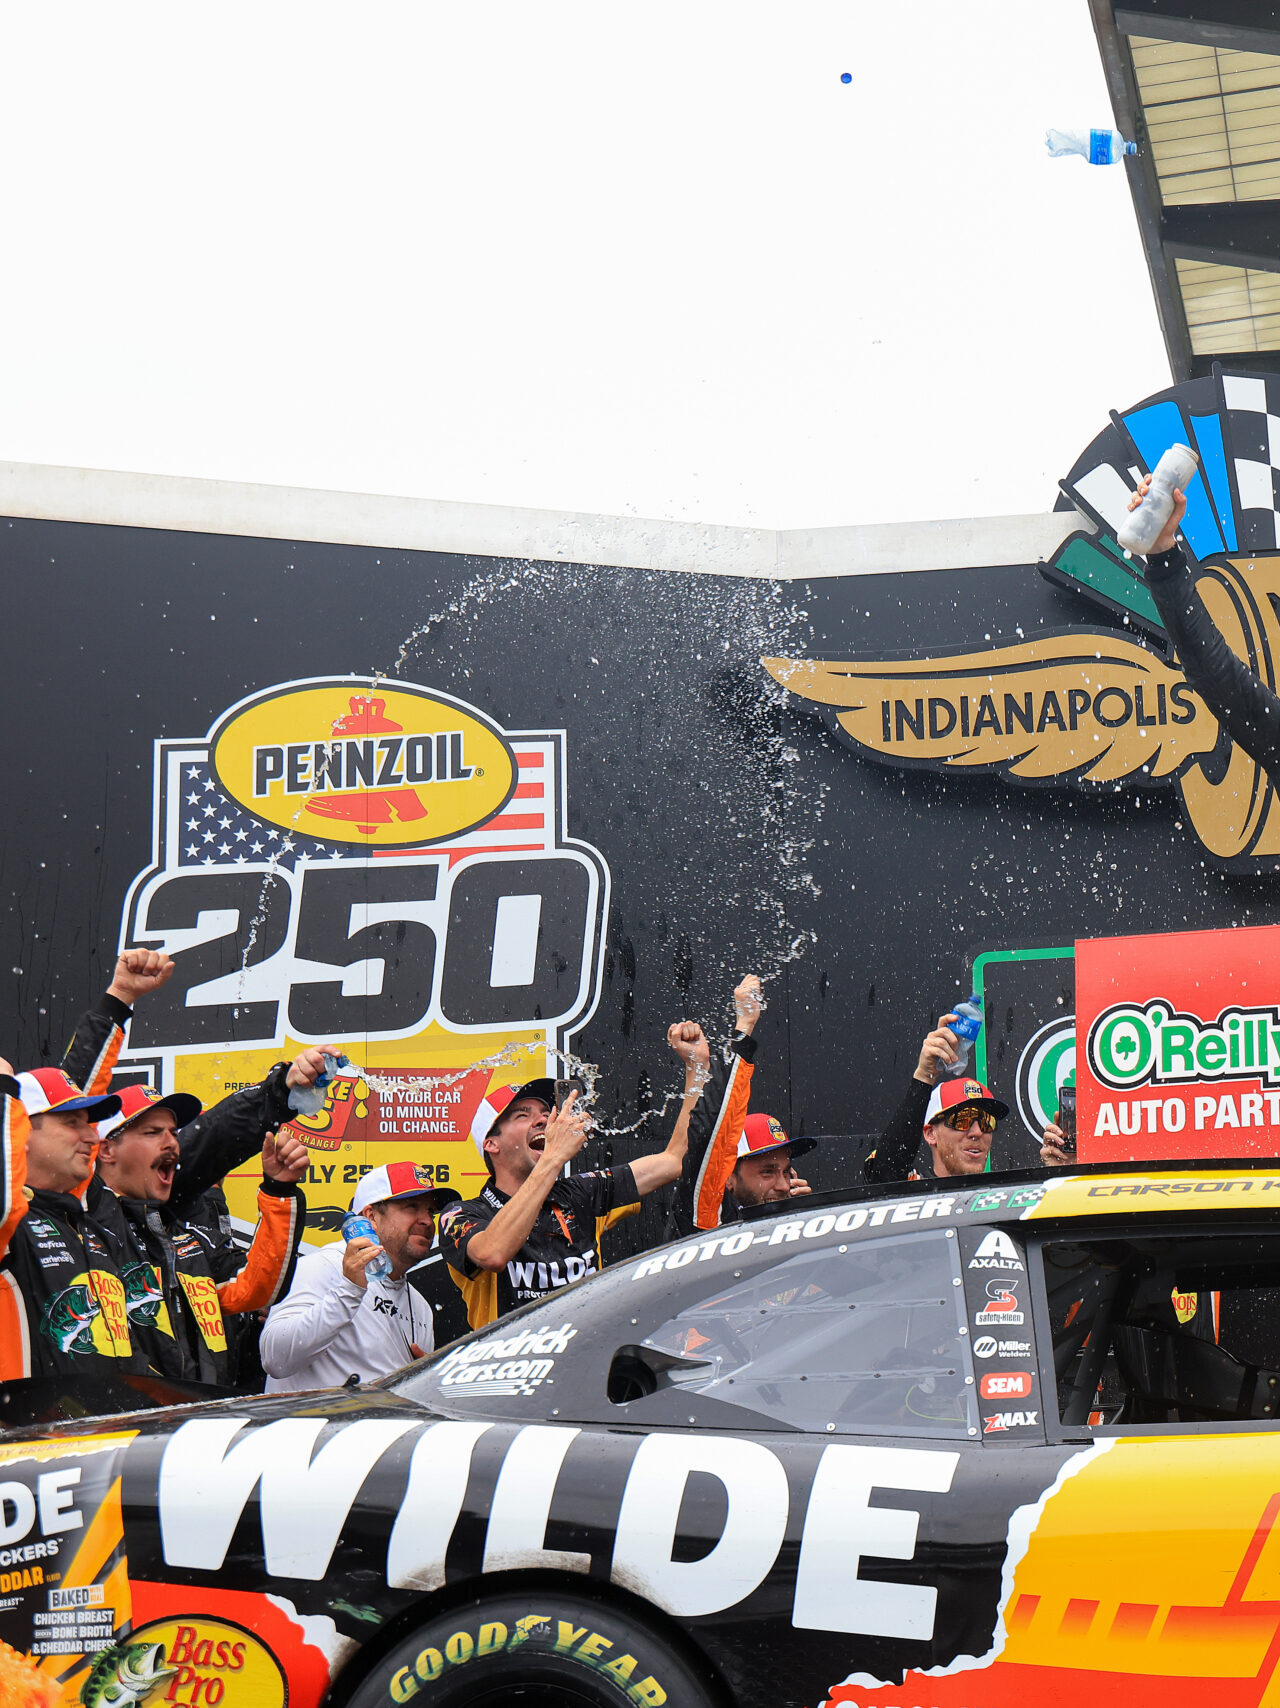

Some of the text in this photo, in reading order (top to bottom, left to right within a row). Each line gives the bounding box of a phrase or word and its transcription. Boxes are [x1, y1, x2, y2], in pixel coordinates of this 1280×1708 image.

[881, 681, 1197, 744] INDIANAPOLIS
[255, 733, 472, 796] PENNZOIL
[128, 857, 591, 1050] 250
[325, 1079, 352, 1101] KE
[379, 1090, 461, 1104] IN YOUR CAR
[380, 1106, 449, 1119] 10 MINUTE
[1093, 1094, 1186, 1138] AUTO
[379, 1120, 460, 1134] OIL CHANGE.
[298, 1133, 336, 1150] CHANGE
[300, 1164, 337, 1184] ULY
[427, 1163, 450, 1183] 26
[1087, 1180, 1265, 1199] CARSON
[631, 1197, 955, 1281] ROTO-ROOTER
[507, 1249, 597, 1289] WILDE
[968, 1258, 1025, 1272] AXALTA
[88, 1271, 123, 1297] Bass
[99, 1296, 123, 1318] Pro
[978, 1311, 1022, 1324] safety-kleen
[105, 1317, 131, 1343] Sho
[437, 1322, 579, 1376] Hendrick
[998, 1340, 1031, 1351] Miller
[998, 1350, 1031, 1358] Welders
[440, 1358, 555, 1386] Cars.com
[987, 1376, 1024, 1394] SEM
[158, 1417, 962, 1640] WILDE
[52, 1588, 89, 1609] BAKED
[34, 1610, 115, 1626] CHICKEN BREAST
[52, 1626, 78, 1639] BONE
[79, 1624, 113, 1638] BROTH
[41, 1640, 83, 1654] CHEDDAR
[166, 1625, 248, 1670] Bass
[163, 1665, 226, 1705] Pro
